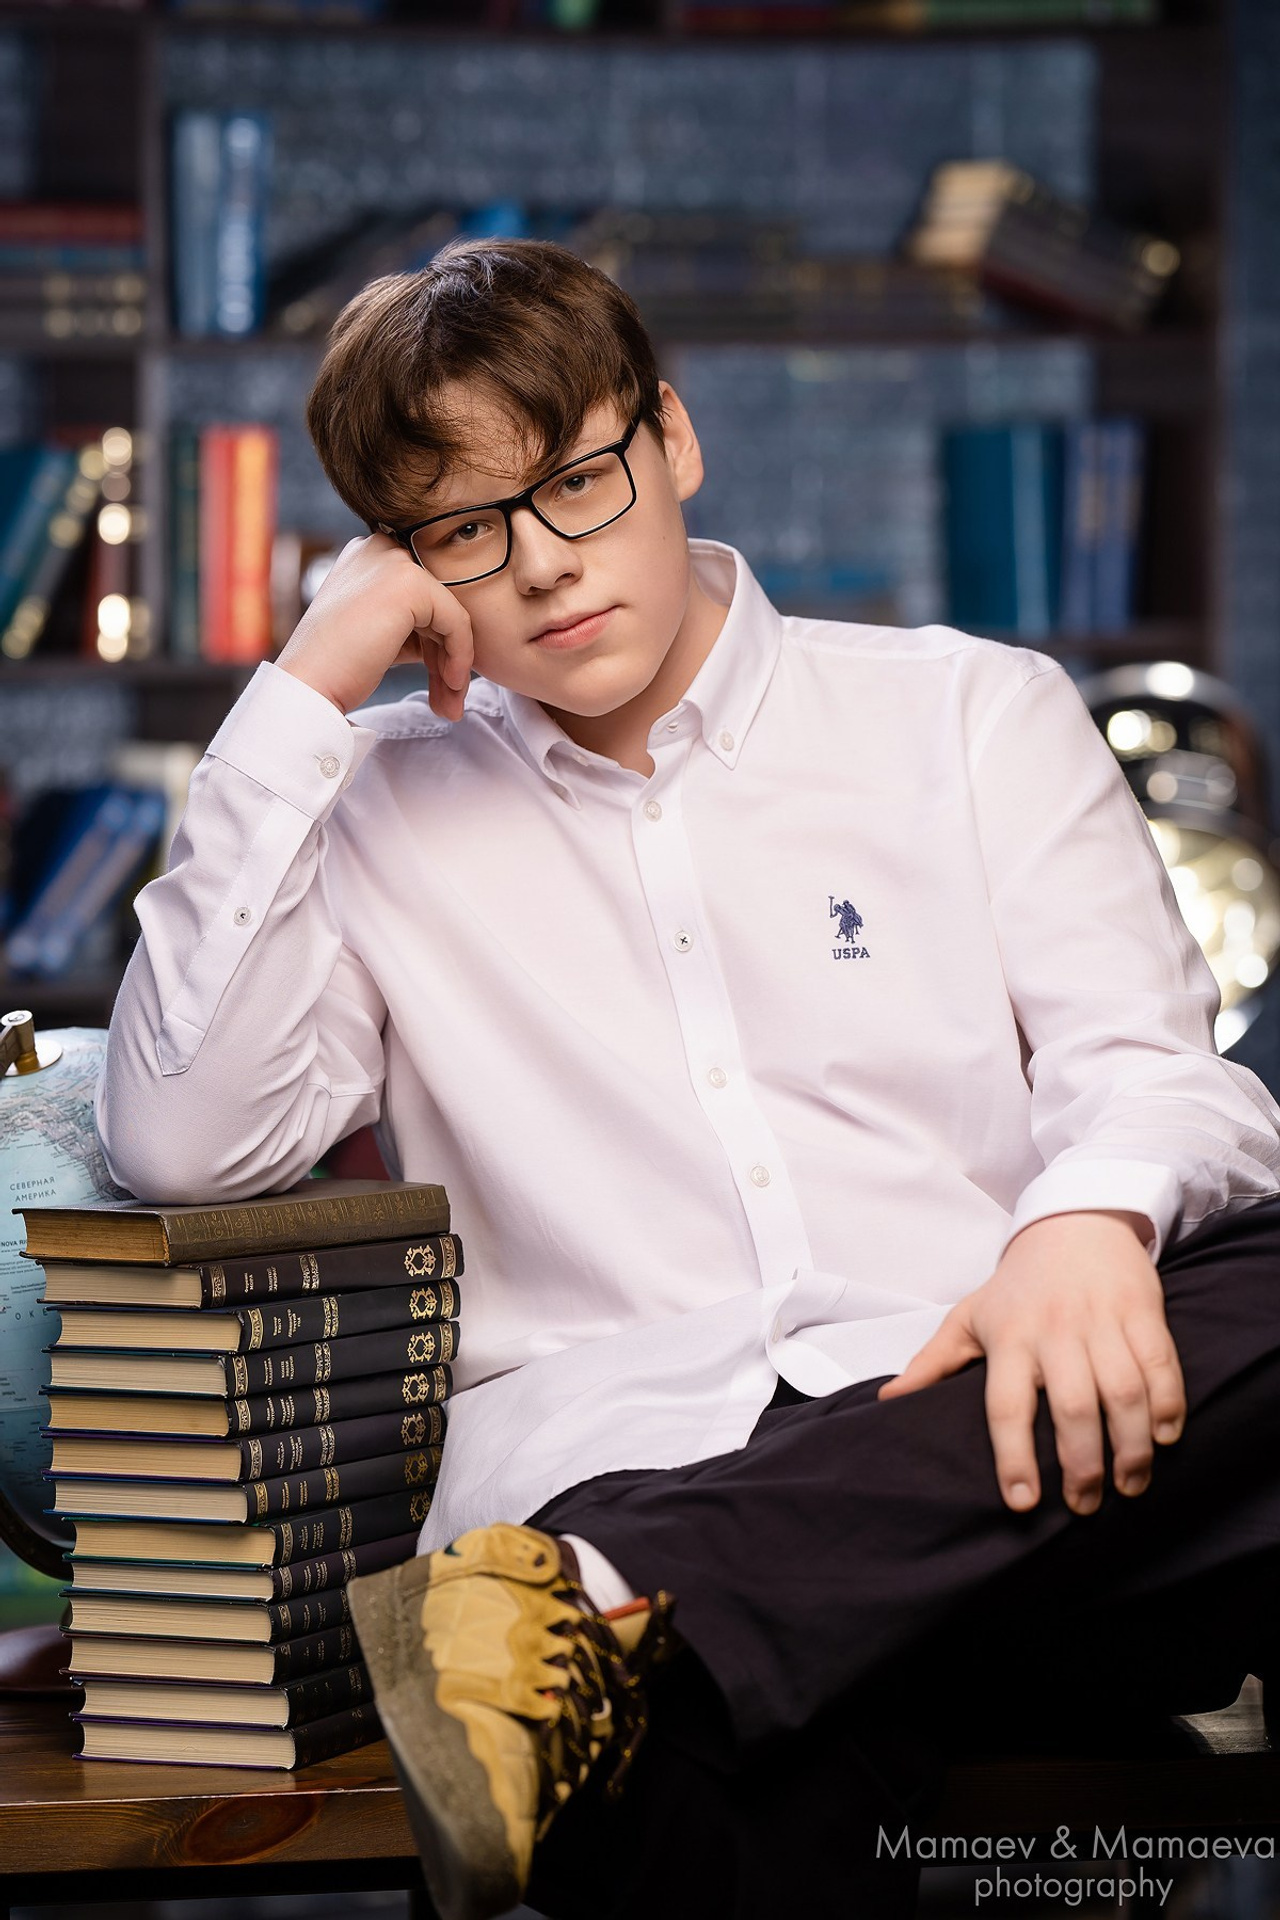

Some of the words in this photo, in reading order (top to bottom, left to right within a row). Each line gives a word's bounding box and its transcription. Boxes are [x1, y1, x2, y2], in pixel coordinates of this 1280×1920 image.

[832, 947, 871, 960] USPA
[10, 1176, 55, 1190] СЕВЕРНАЯ
[15, 1189, 57, 1202] АМЕРИКА
